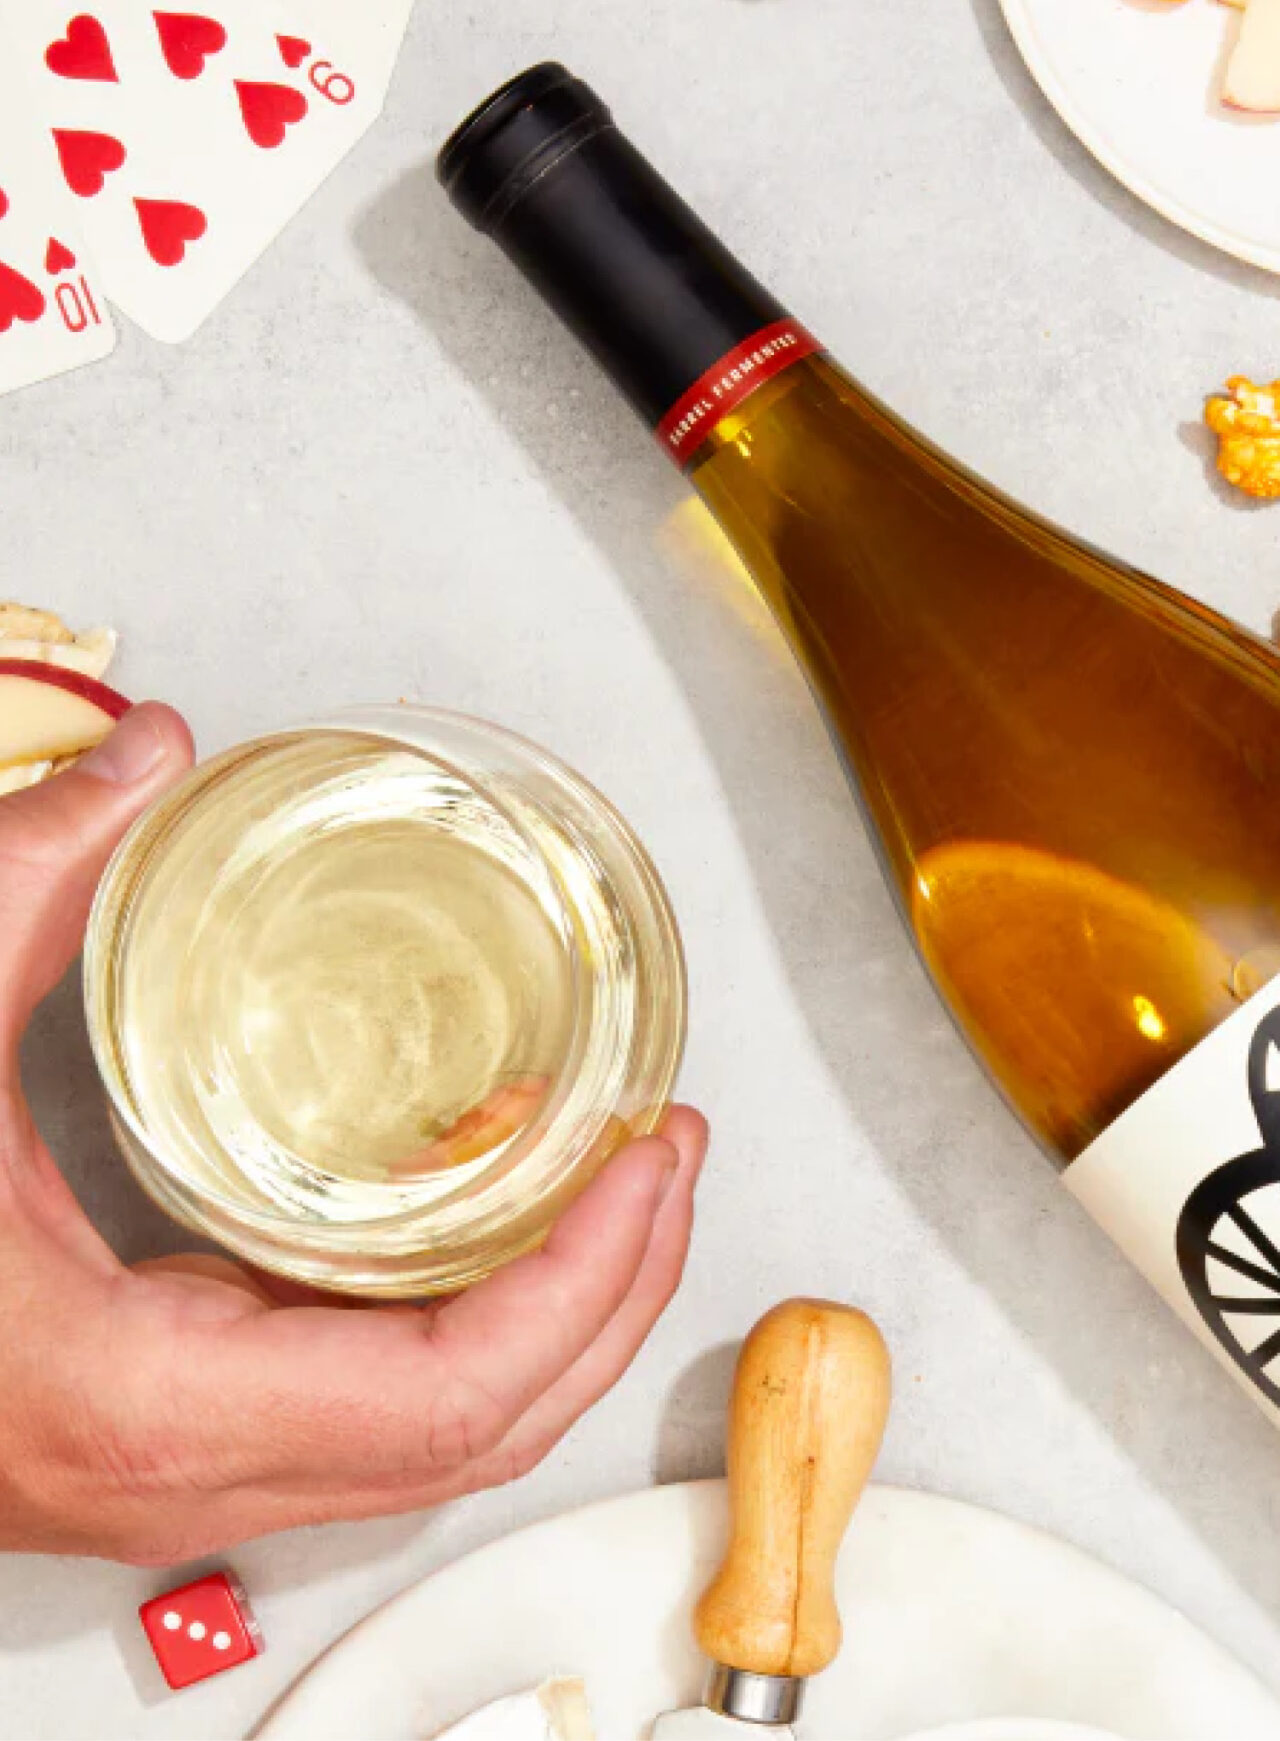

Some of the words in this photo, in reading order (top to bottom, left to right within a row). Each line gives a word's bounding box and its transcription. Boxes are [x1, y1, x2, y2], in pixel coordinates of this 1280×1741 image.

[54, 274, 102, 332] 10
[669, 400, 713, 446] BARREL
[712, 333, 797, 399] FERMENTED
